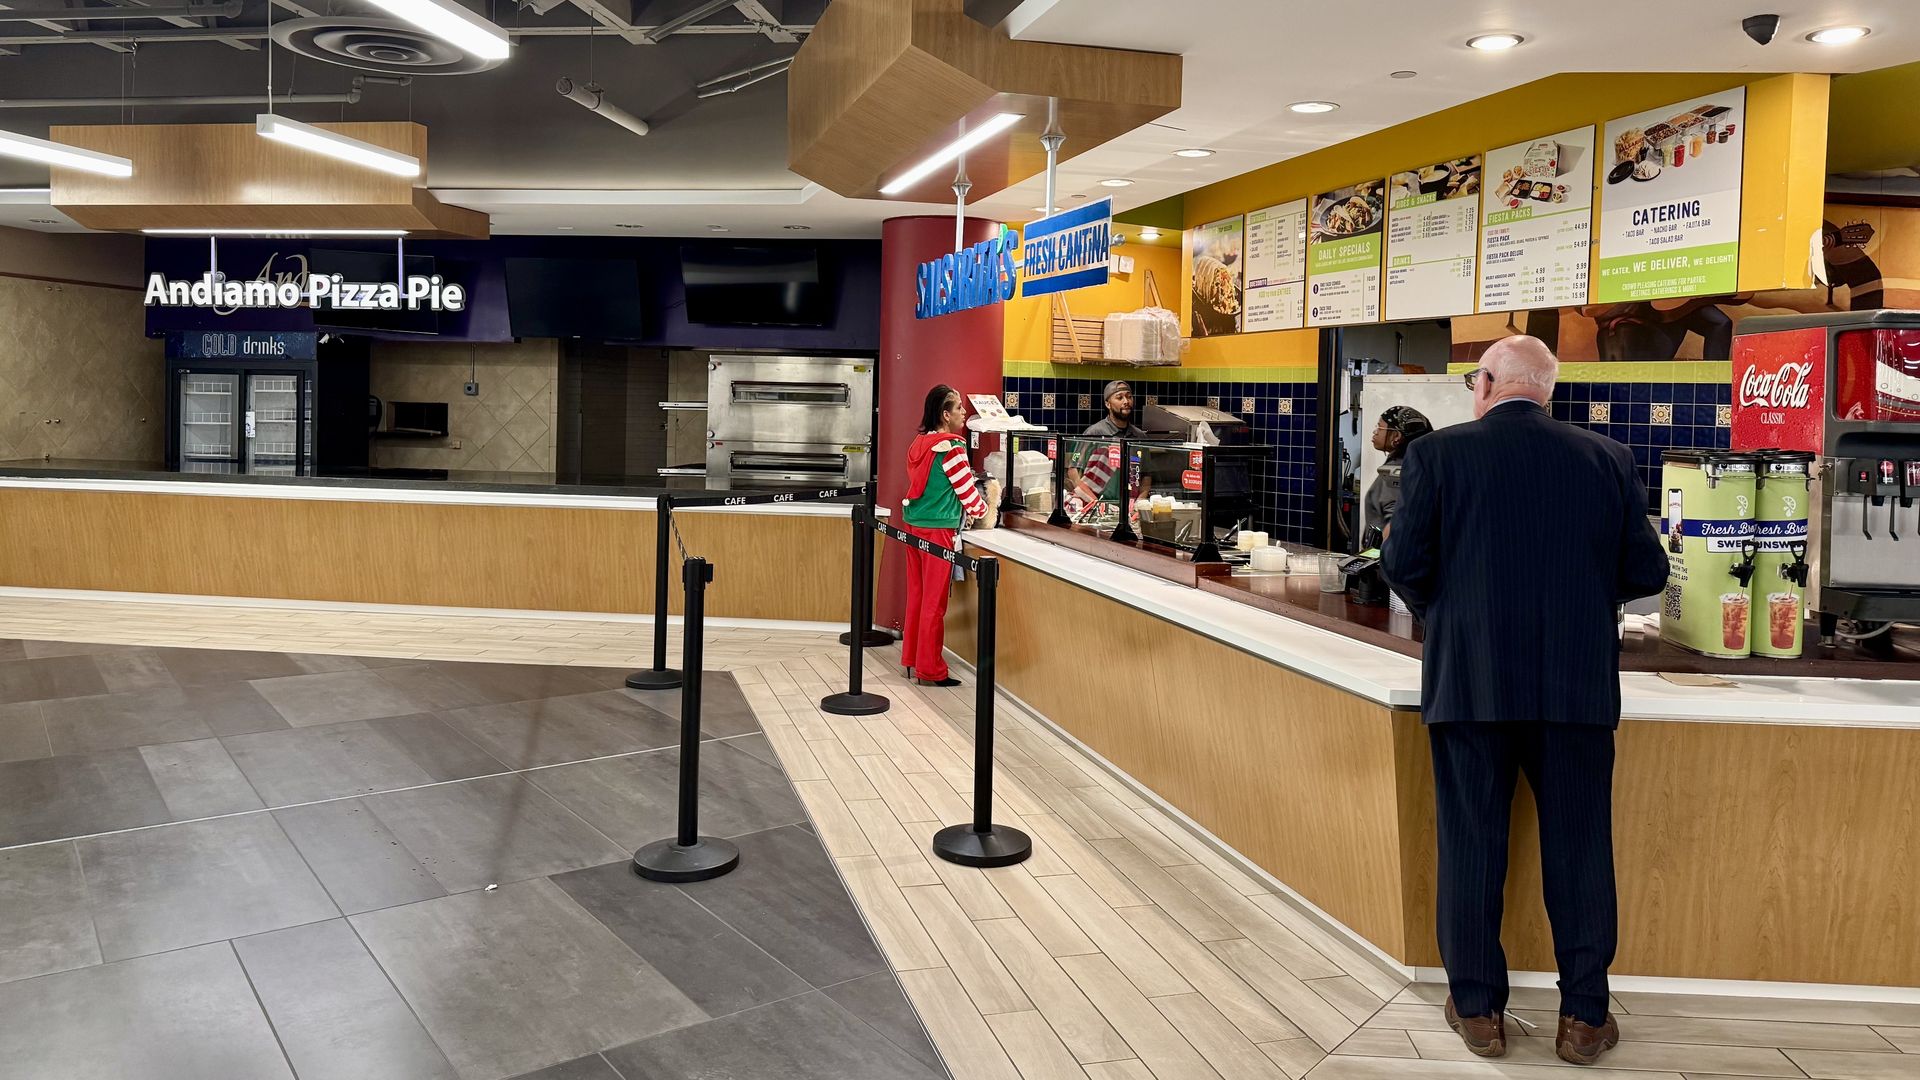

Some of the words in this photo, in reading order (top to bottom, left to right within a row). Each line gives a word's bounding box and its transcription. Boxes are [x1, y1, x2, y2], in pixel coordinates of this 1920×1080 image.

[1488, 211, 1508, 223] FIESTA
[1511, 208, 1531, 218] PACKS
[1632, 200, 1700, 226] CATERING
[1686, 221, 1701, 229] FAJITA
[1701, 219, 1711, 227] BAR
[1625, 229, 1636, 238] TACO
[1636, 228, 1645, 236] BAR
[1649, 237, 1660, 245] TACO
[1674, 234, 1684, 242] BAR
[1023, 237, 1055, 277] FRESH
[1058, 222, 1109, 270] CANTINA
[1318, 248, 1337, 260] DAILY
[1339, 241, 1371, 257] SPECIALS
[1633, 261, 1647, 273] WE
[1650, 256, 1690, 271] DELIVER,
[1693, 258, 1703, 266] WE
[1705, 254, 1734, 265] DELIGHT!
[144, 272, 303, 308] Andiamo
[309, 273, 402, 310] Pizza
[407, 275, 466, 310] Pie
[202, 333, 237, 356] COLD
[243, 335, 285, 356] drinks
[1740, 361, 1814, 408] Coca-Cola
[1760, 412, 1785, 424] CLASSIC
[724, 496, 746, 505] CAFE
[773, 493, 794, 502] CAFE
[819, 489, 838, 498] CAFE
[1701, 522, 1736, 535] Fresh
[1737, 521, 1754, 534] Bre
[1754, 522, 1782, 534] resh
[877, 522, 887, 533] CAFE
[896, 530, 907, 542] CAFE
[918, 539, 930, 552] CAFE
[943, 549, 956, 563] CAFE
[1717, 539, 1741, 547] SWE
[1757, 540, 1790, 548] UNSW
